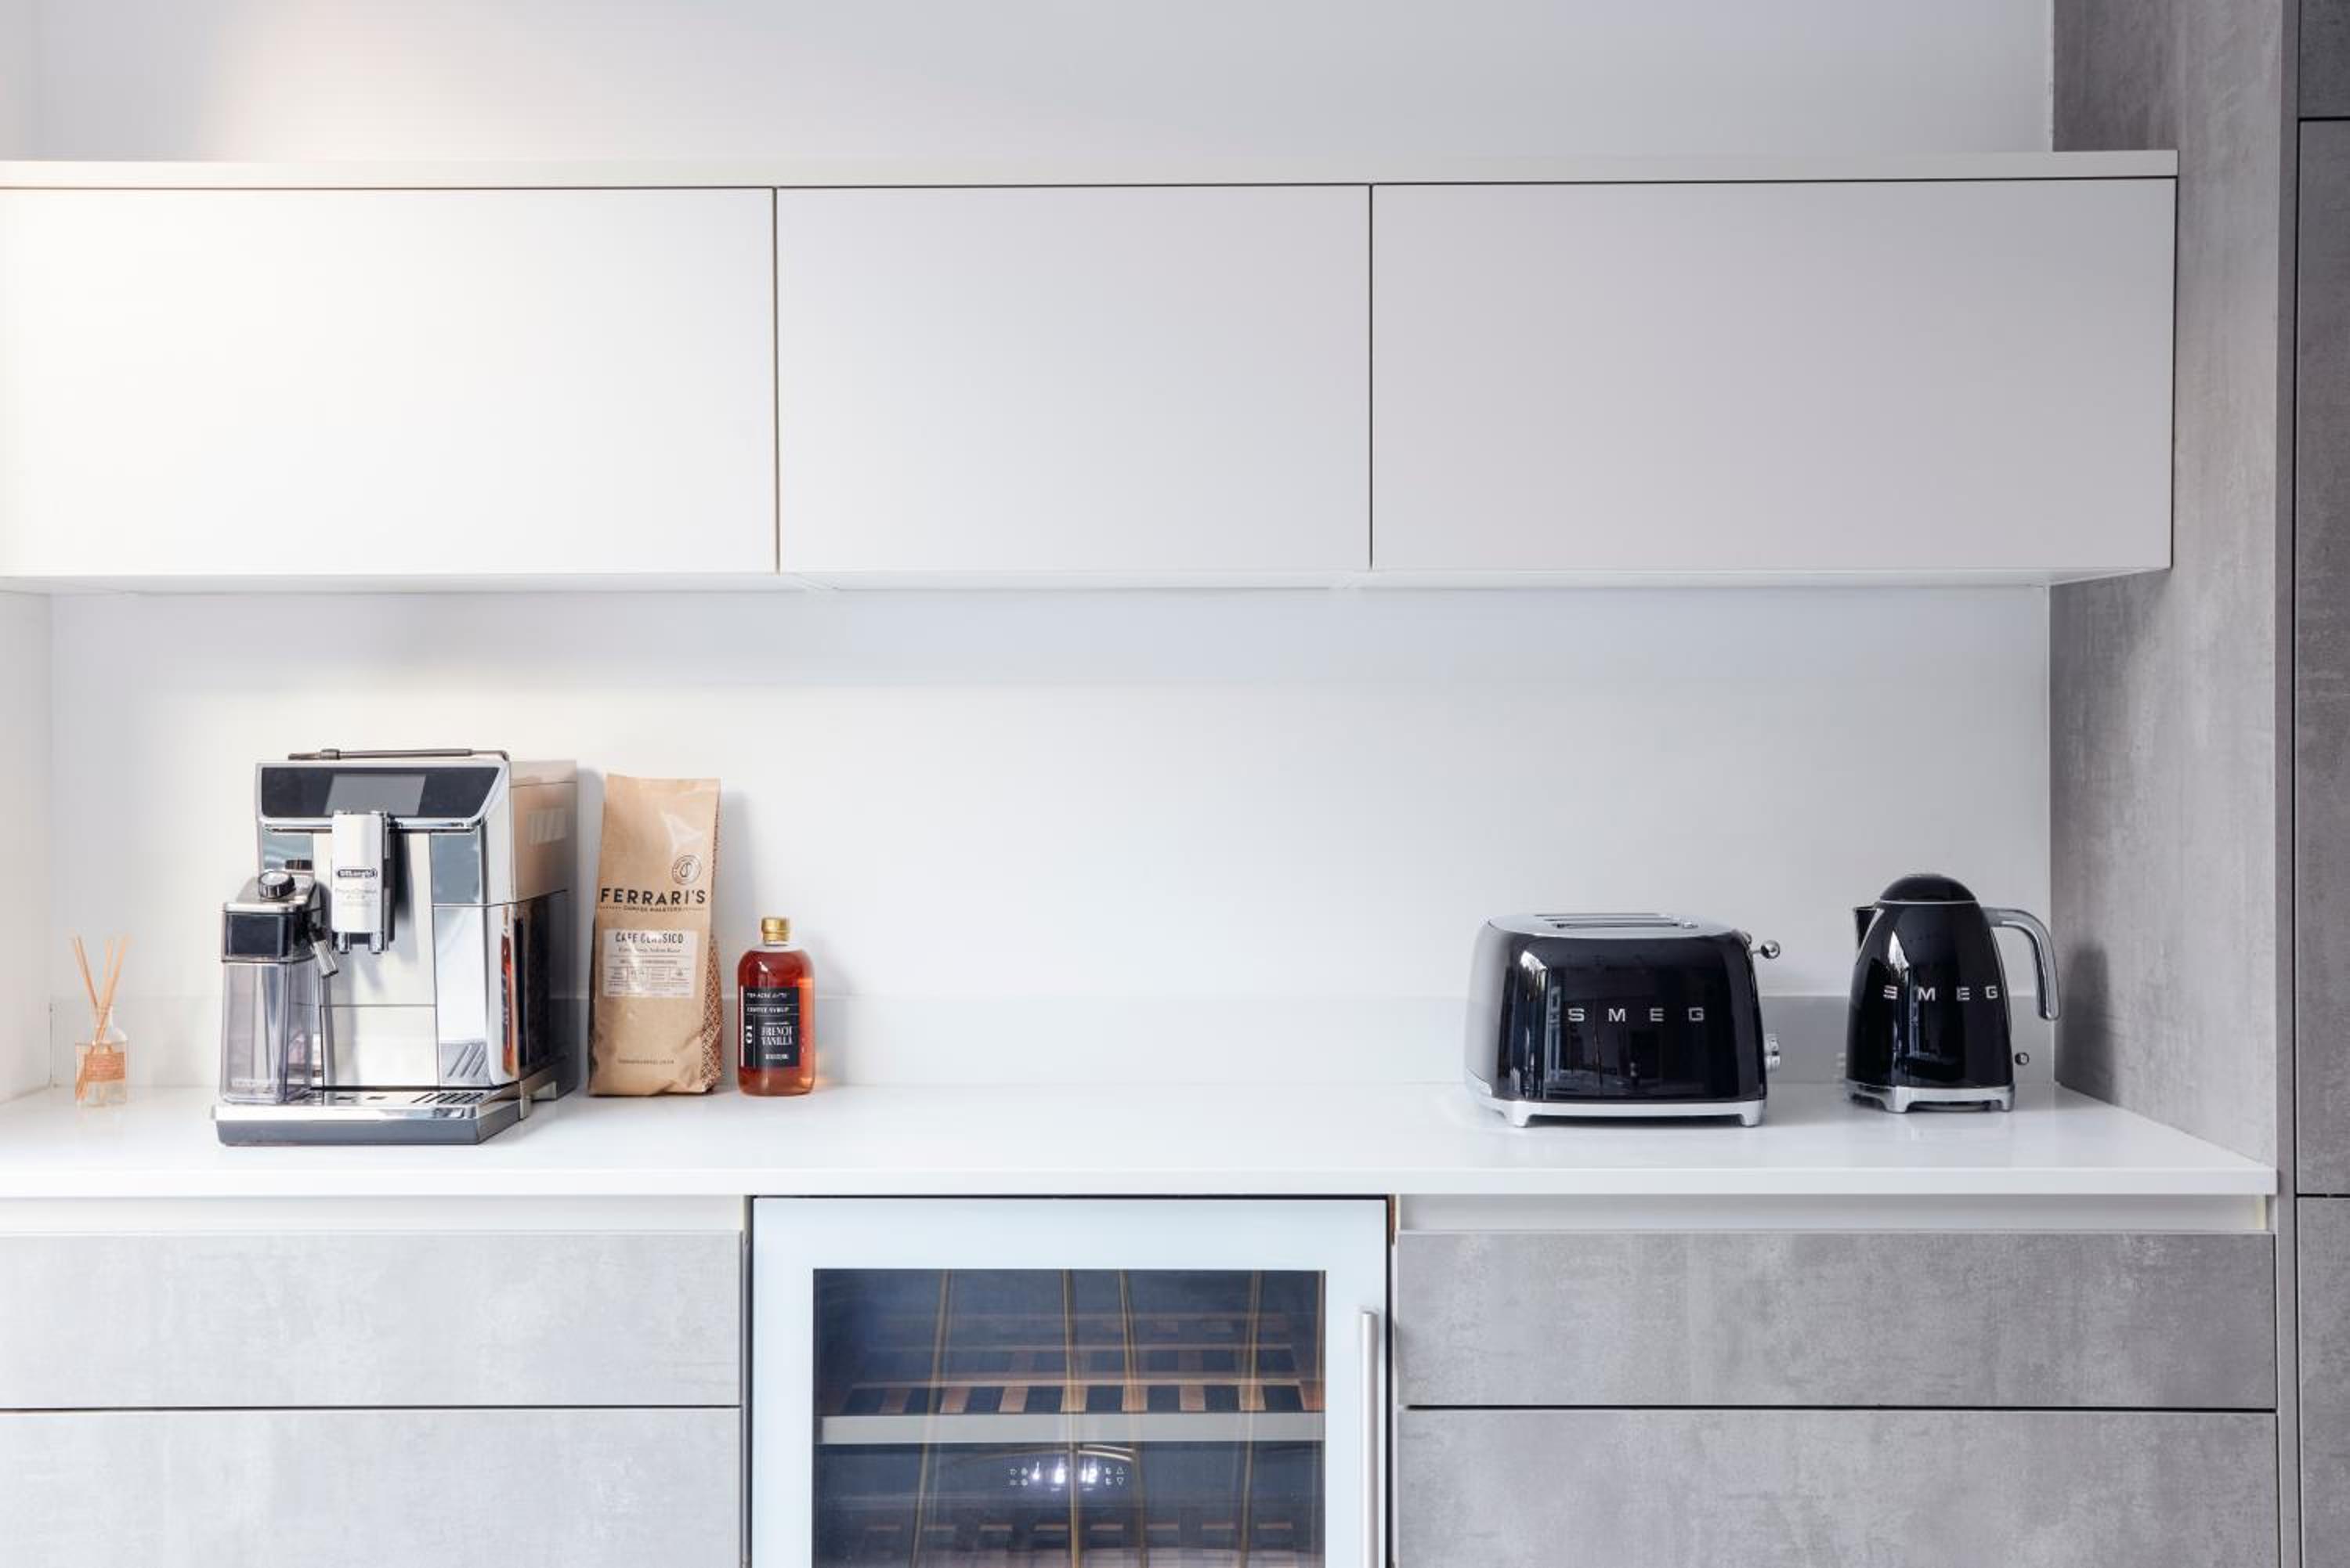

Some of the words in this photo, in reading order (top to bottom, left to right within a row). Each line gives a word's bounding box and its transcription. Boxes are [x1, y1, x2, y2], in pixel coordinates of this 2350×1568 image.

[601, 887, 706, 905] FERRARI'S
[1883, 985, 1998, 1002] SMEG
[1567, 1007, 1705, 1022] SMEG
[761, 1026, 793, 1036] FRENCH
[761, 1036, 794, 1046] VANILLA
